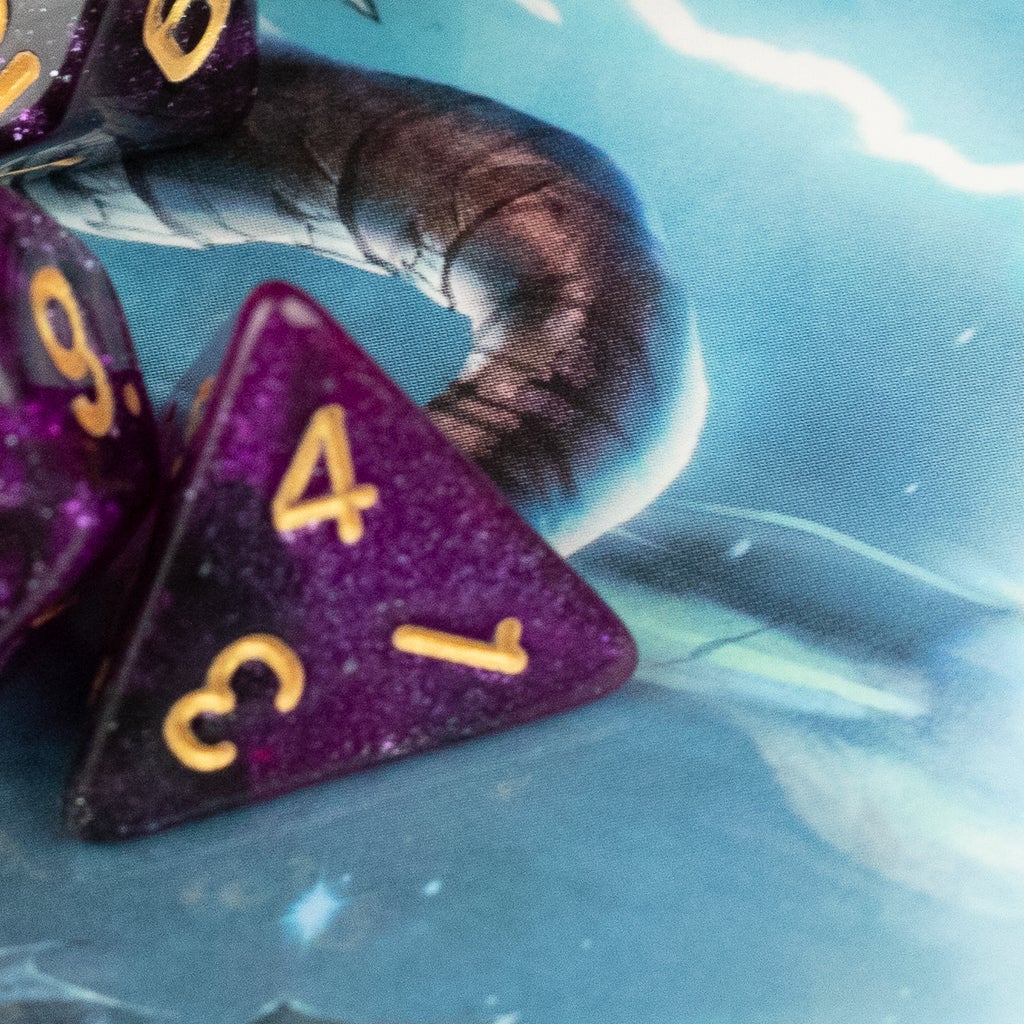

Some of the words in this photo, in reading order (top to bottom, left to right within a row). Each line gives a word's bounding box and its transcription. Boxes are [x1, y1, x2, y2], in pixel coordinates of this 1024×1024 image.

[273, 408, 377, 542] 4
[164, 635, 304, 773] 3
[395, 621, 528, 675] 1
